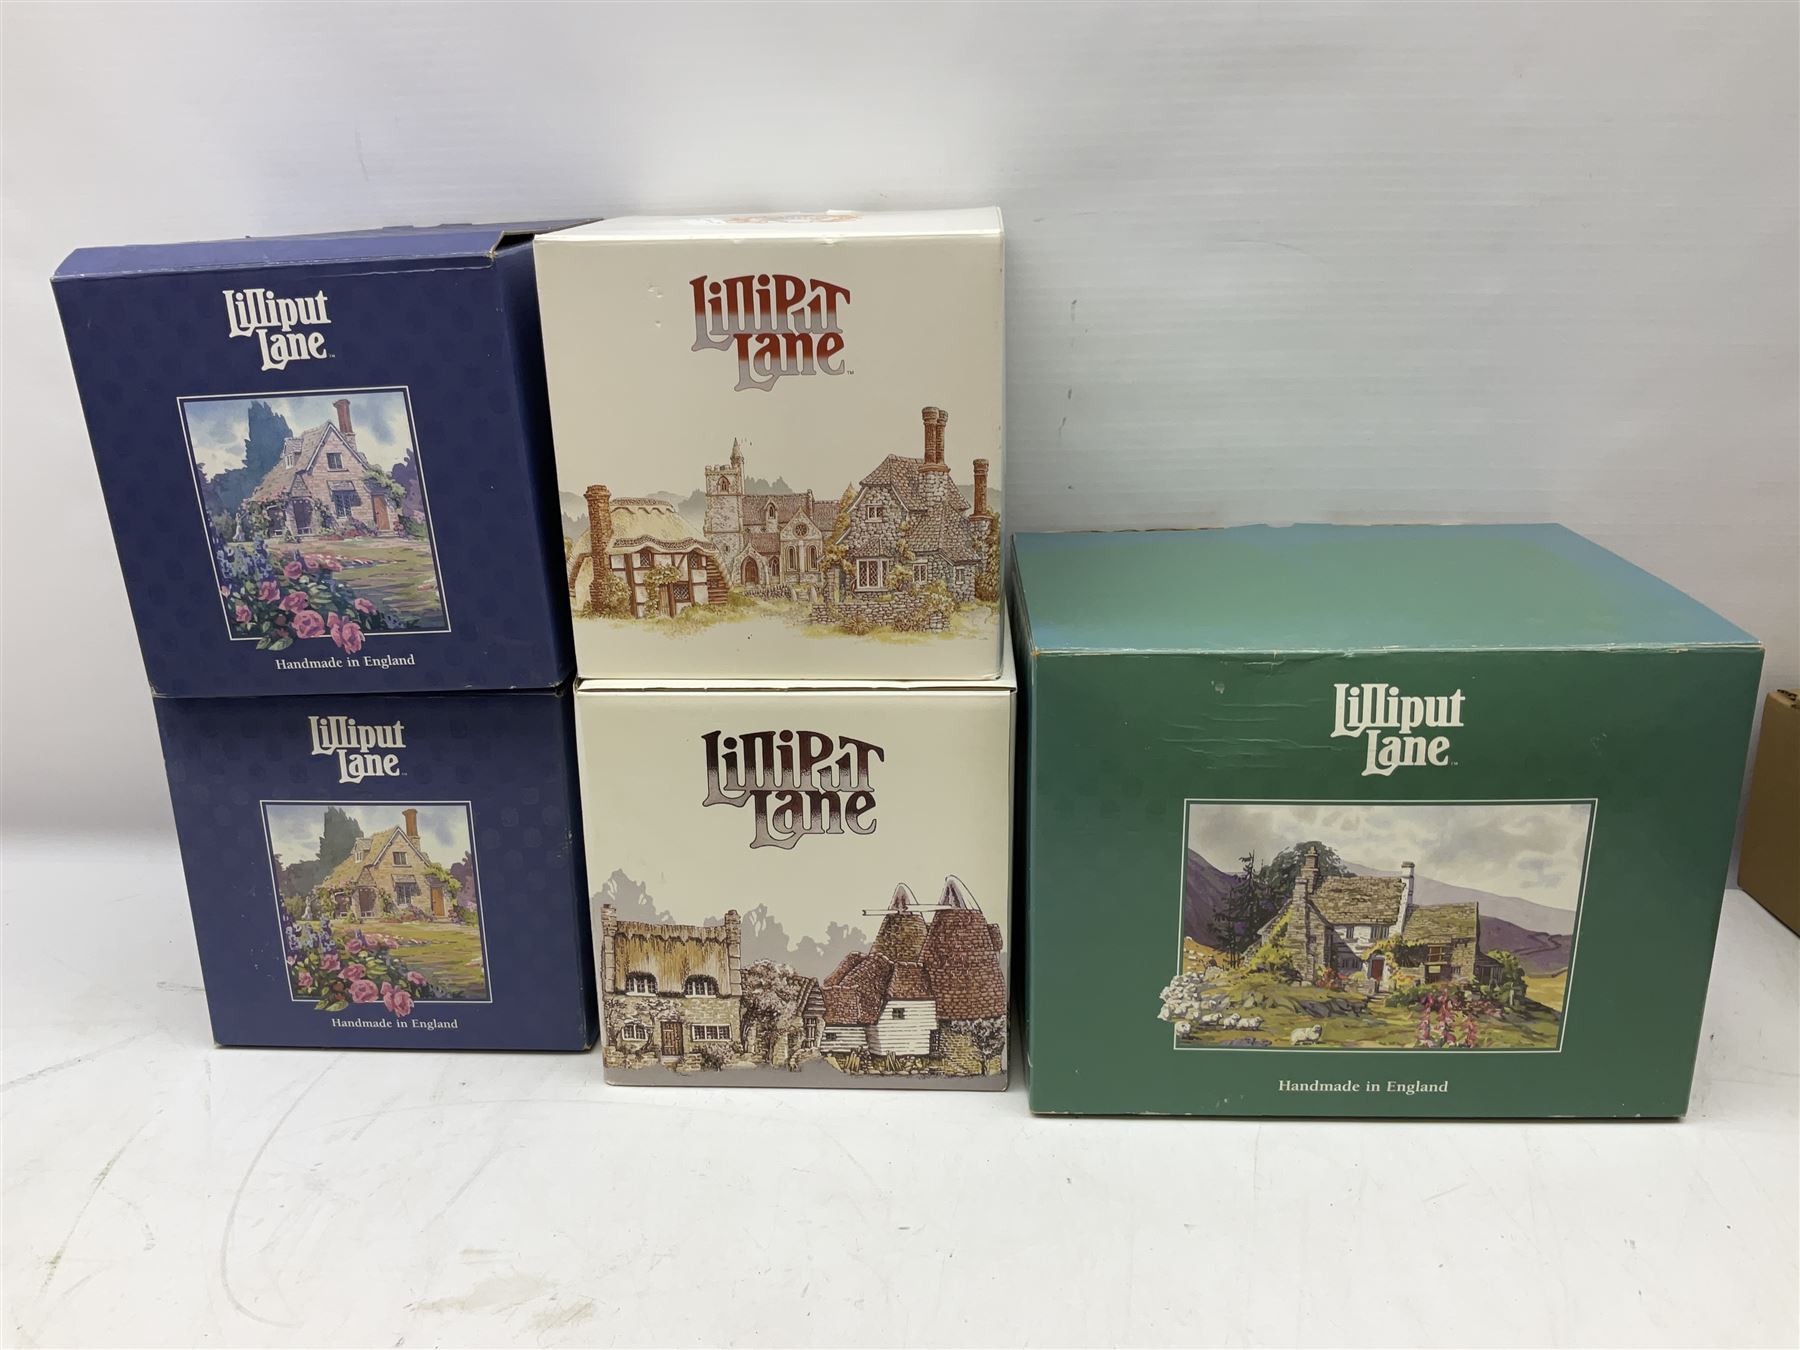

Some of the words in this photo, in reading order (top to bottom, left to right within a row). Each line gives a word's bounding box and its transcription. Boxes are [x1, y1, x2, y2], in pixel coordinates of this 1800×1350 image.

[222, 288, 332, 338] Lilliput
[255, 329, 328, 371] Lane
[733, 331, 846, 392] Lane
[274, 657, 344, 670] Handmade
[346, 656, 361, 668] in
[363, 654, 416, 670] England
[1330, 683, 1466, 738] Lilliput
[308, 715, 407, 755] Lilliput
[1361, 729, 1451, 777] Lane
[336, 749, 401, 784] Lane
[749, 790, 878, 850] Lane
[331, 1018, 393, 1029] Handmade
[396, 1018, 408, 1029] in
[411, 1018, 459, 1031] England
[1278, 1080, 1361, 1093] Handmade
[1366, 1080, 1381, 1093] in
[1386, 1080, 1449, 1096] England
